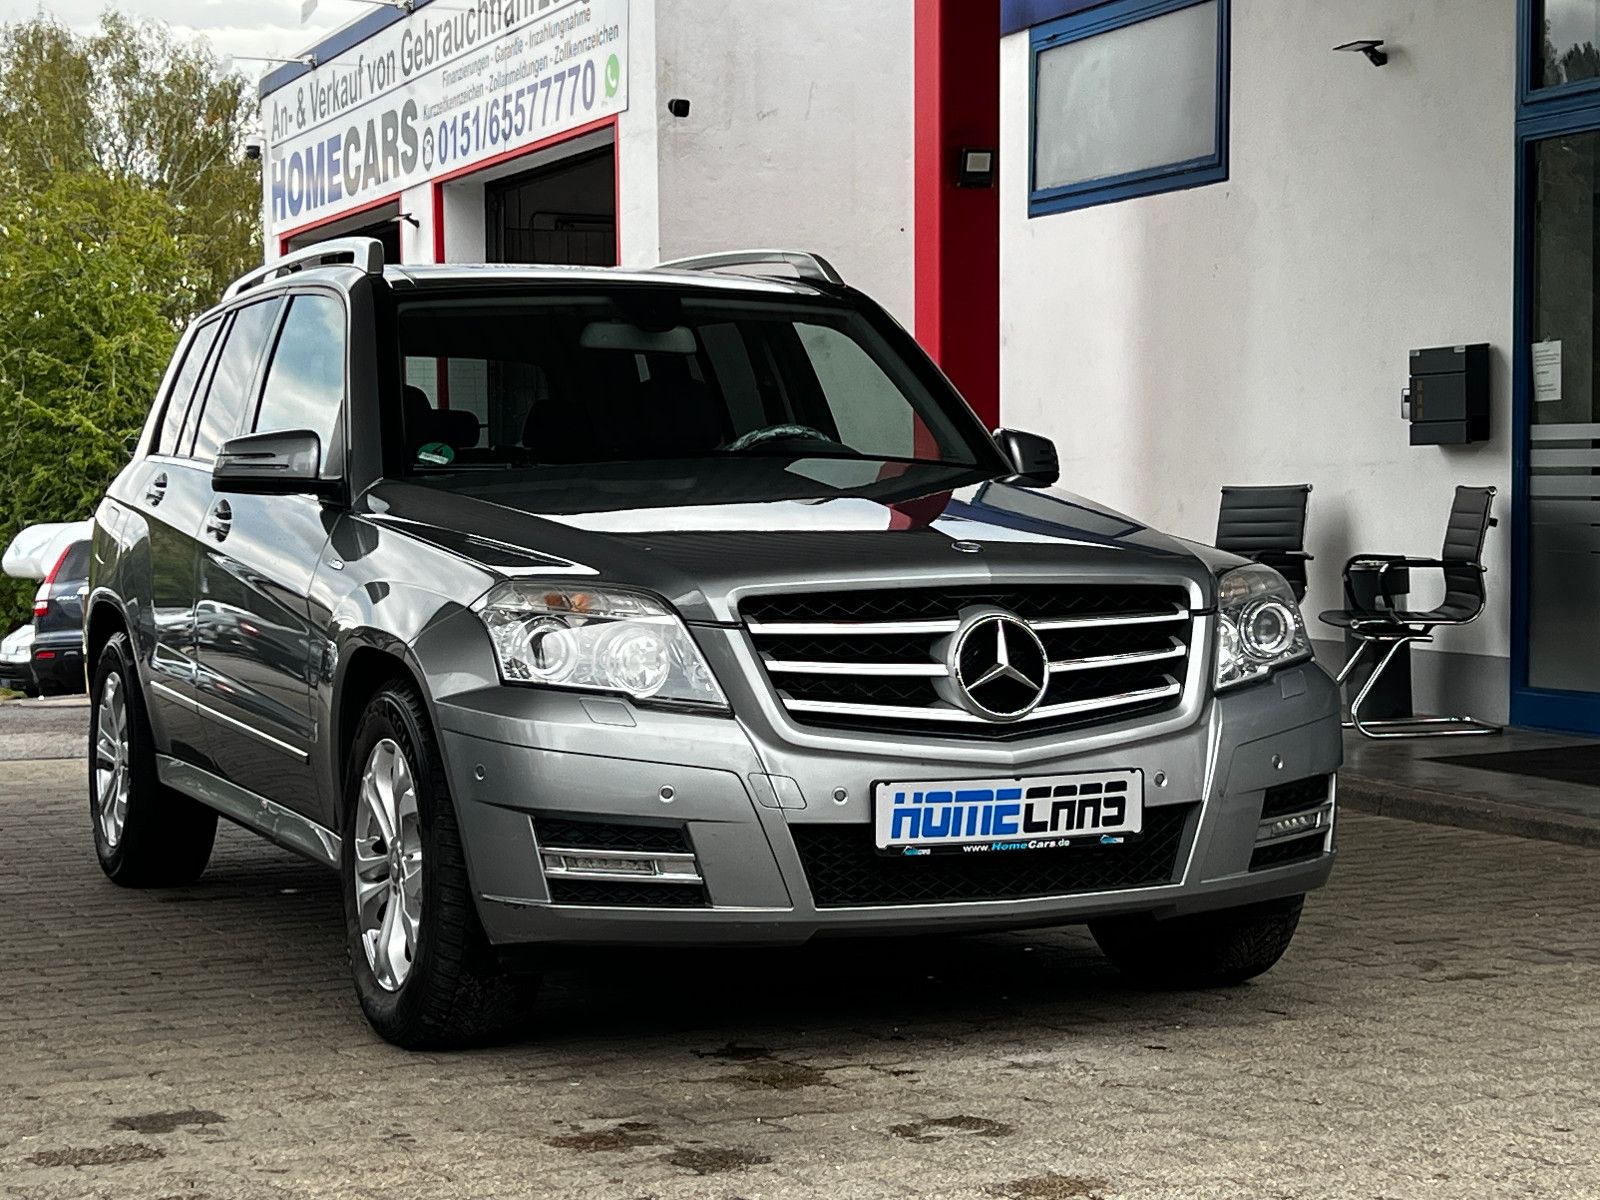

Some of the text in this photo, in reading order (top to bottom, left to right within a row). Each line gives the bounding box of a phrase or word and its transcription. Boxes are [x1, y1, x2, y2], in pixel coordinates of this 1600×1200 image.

[442, 6, 591, 88] Finanzierungen Garantie Inzahlungnahme
[488, 54, 549, 93] Zollanmeldungen
[553, 23, 619, 65] Zollkennzeichen
[296, 86, 306, 130] &
[310, 54, 364, 123] Verkauf
[367, 49, 396, 95] von
[271, 58, 596, 224] HOMECARS 0151/65577770
[962, 838, 1070, 852] www.HomeCars.de
